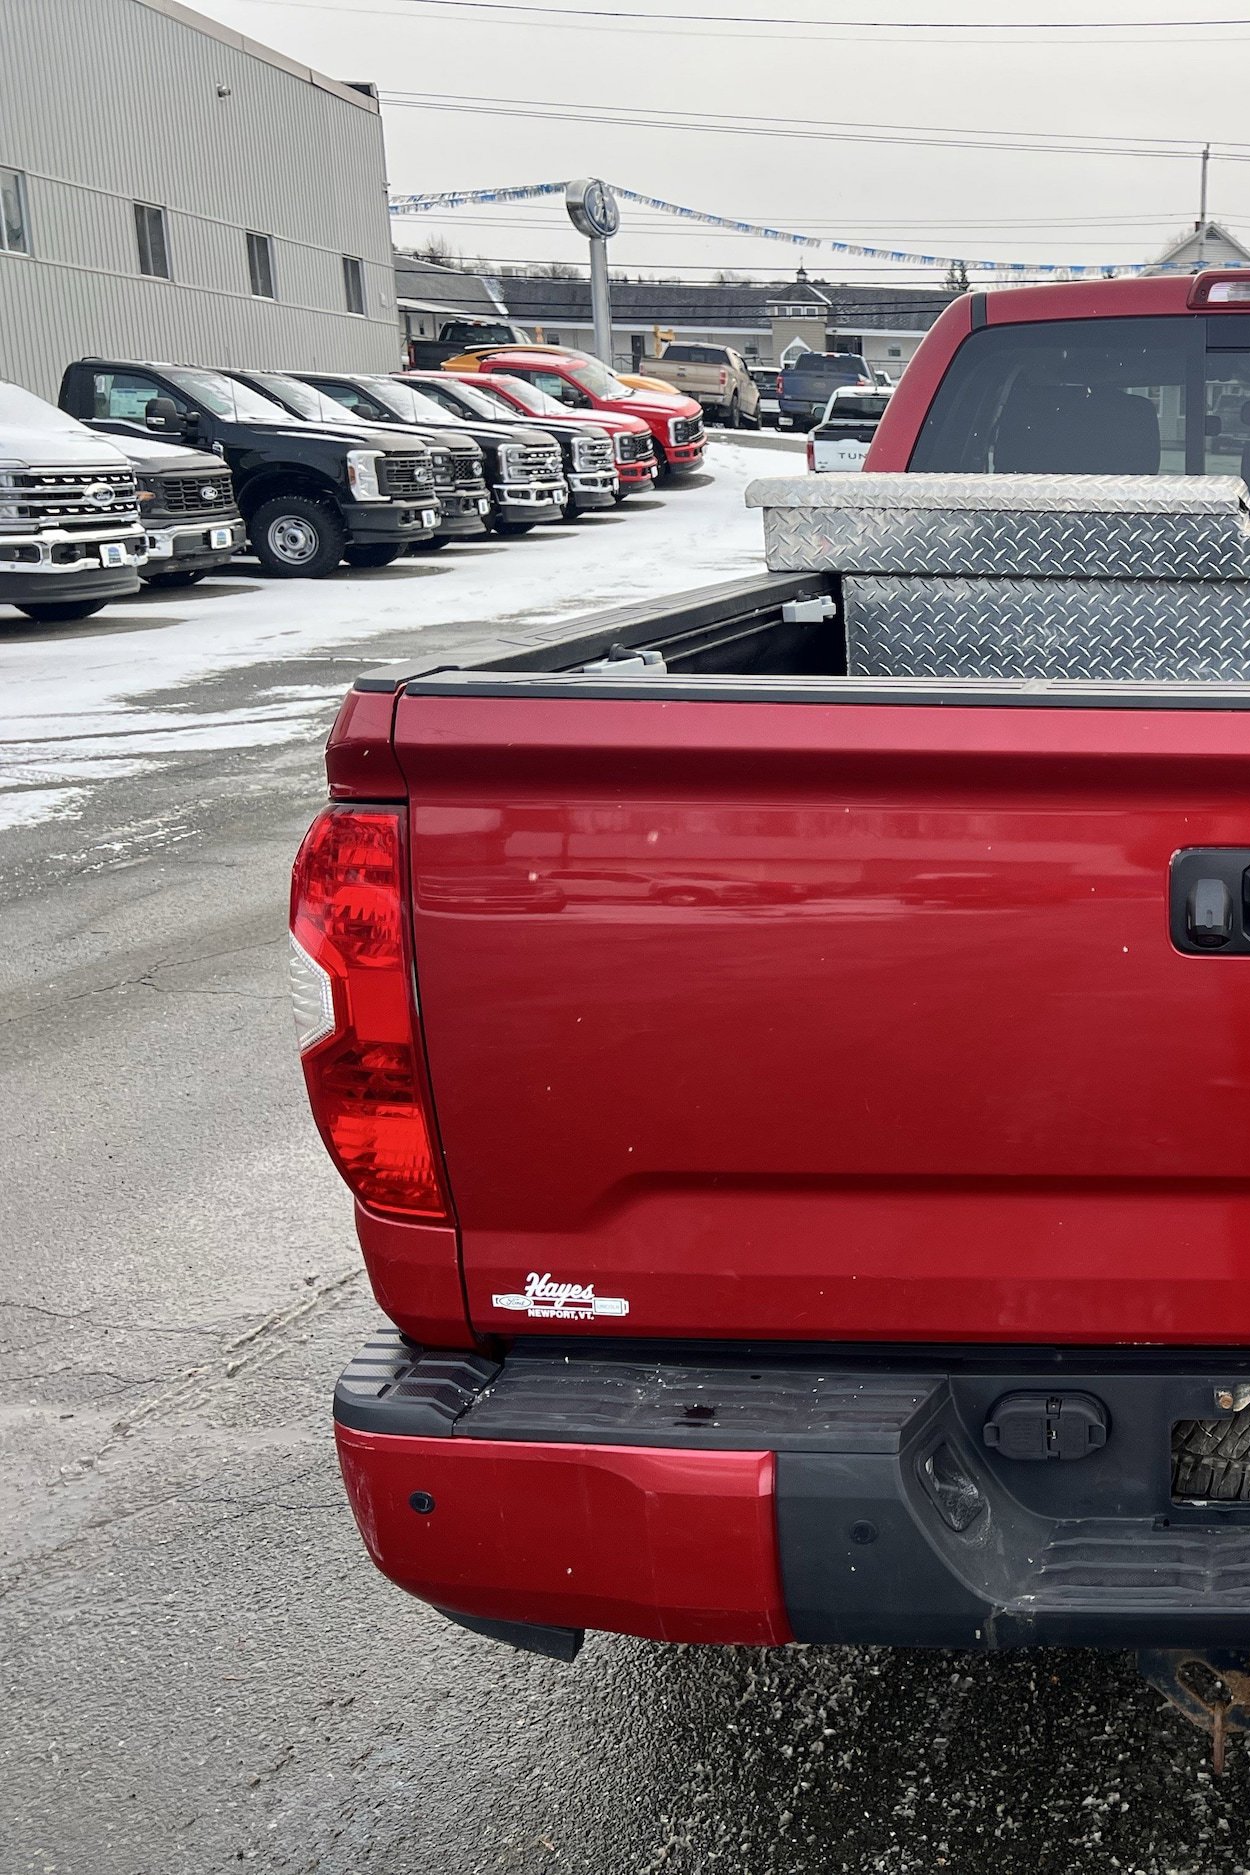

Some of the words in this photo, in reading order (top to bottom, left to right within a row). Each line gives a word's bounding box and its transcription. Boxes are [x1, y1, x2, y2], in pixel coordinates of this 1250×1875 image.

[525, 1272, 596, 1308] Hayes
[528, 1308, 579, 1320] NEWPORT,
[579, 1311, 595, 1320] VT.
